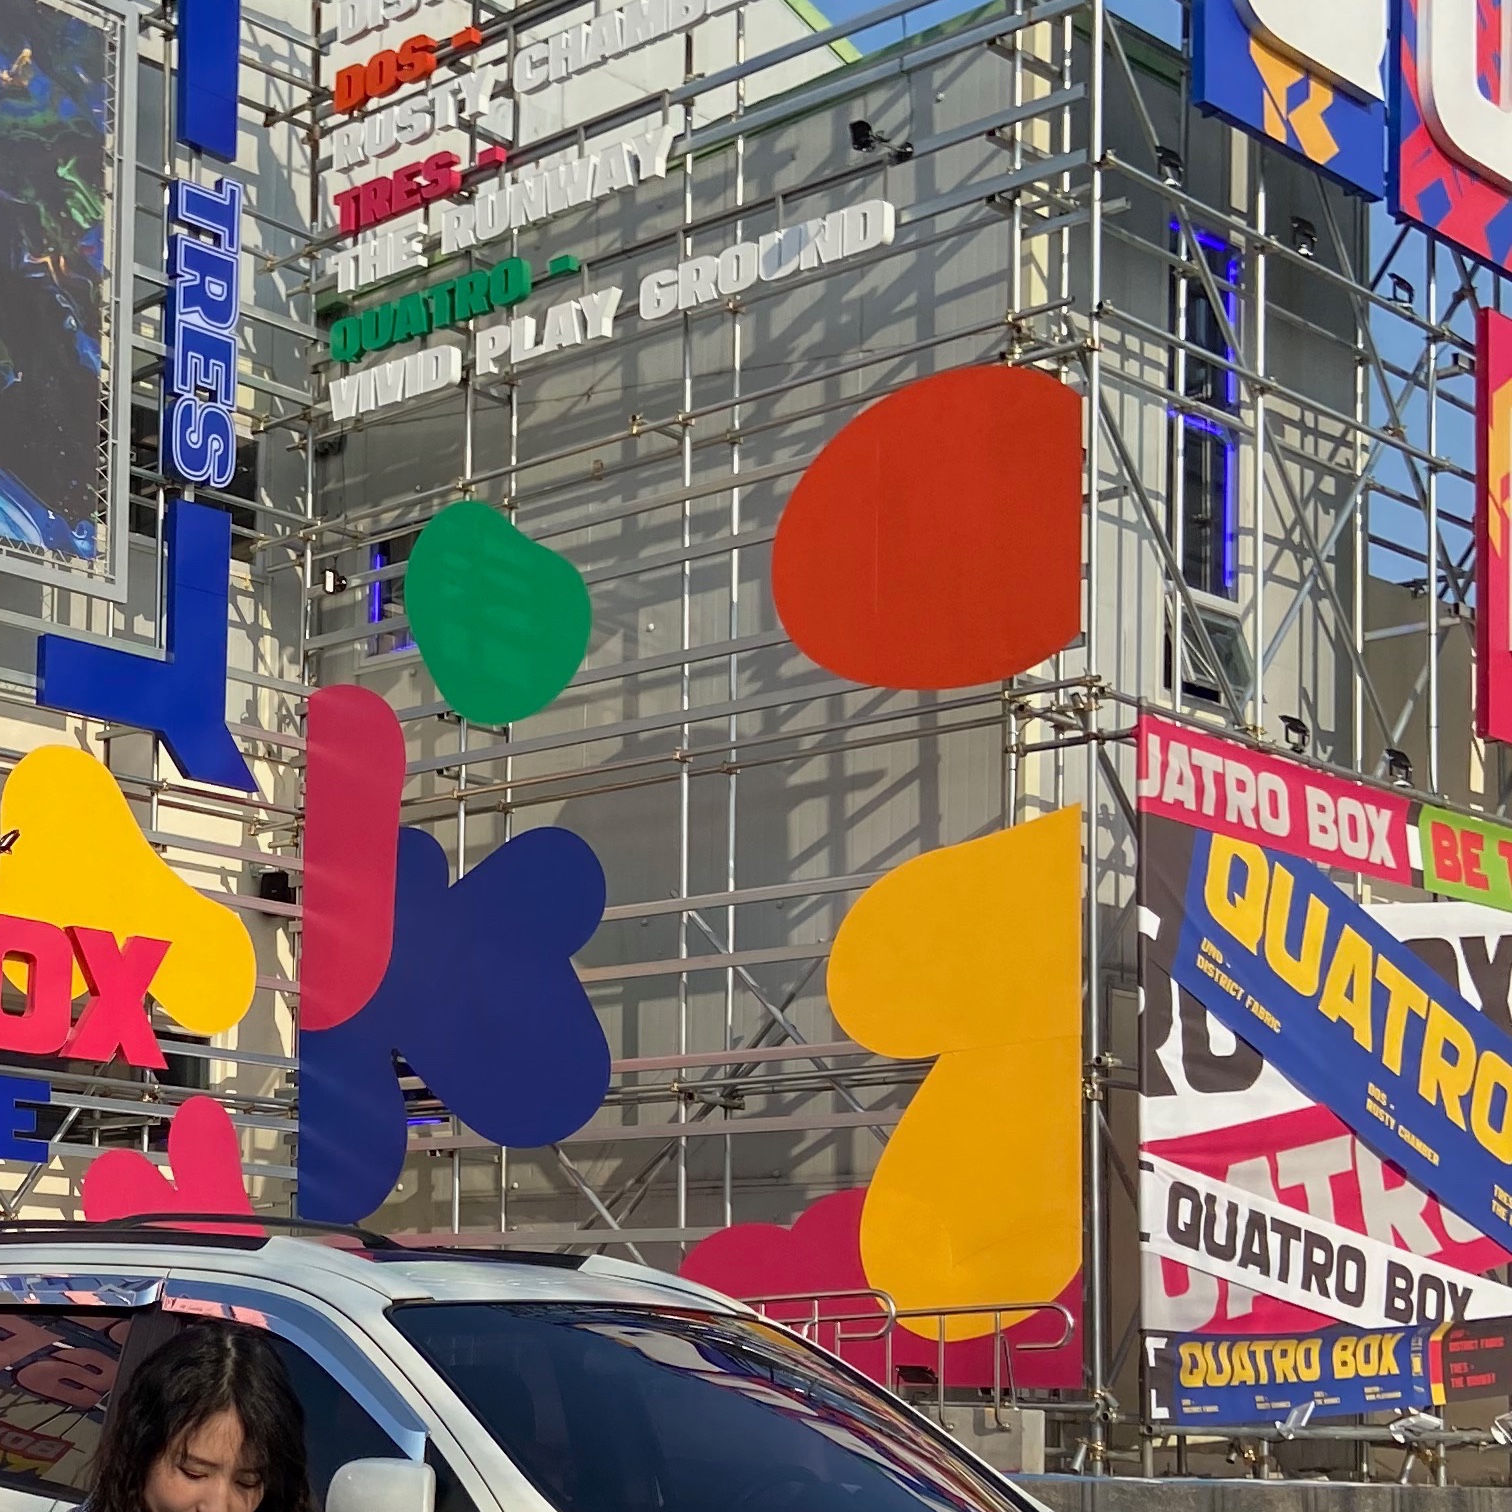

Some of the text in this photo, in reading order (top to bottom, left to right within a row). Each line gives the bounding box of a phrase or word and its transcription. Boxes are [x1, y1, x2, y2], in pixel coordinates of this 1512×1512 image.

[332, 65, 496, 174] RUSTY
[334, 34, 437, 115] DOS
[332, 125, 682, 294] THE RUNWAY
[334, 150, 462, 235] TRES
[167, 177, 244, 488] TRES
[329, 257, 532, 363] QUATRO
[329, 200, 895, 422] VIVID PLAY GROUND
[1305, 785, 1398, 870] BOX
[1430, 820, 1491, 891] BE
[1204, 836, 1512, 1165] QUATRO
[1167, 1181, 1474, 1325] QUATRO BOX
[1178, 1337, 1323, 1388] QUATRO
[1332, 1333, 1405, 1379] BOX
